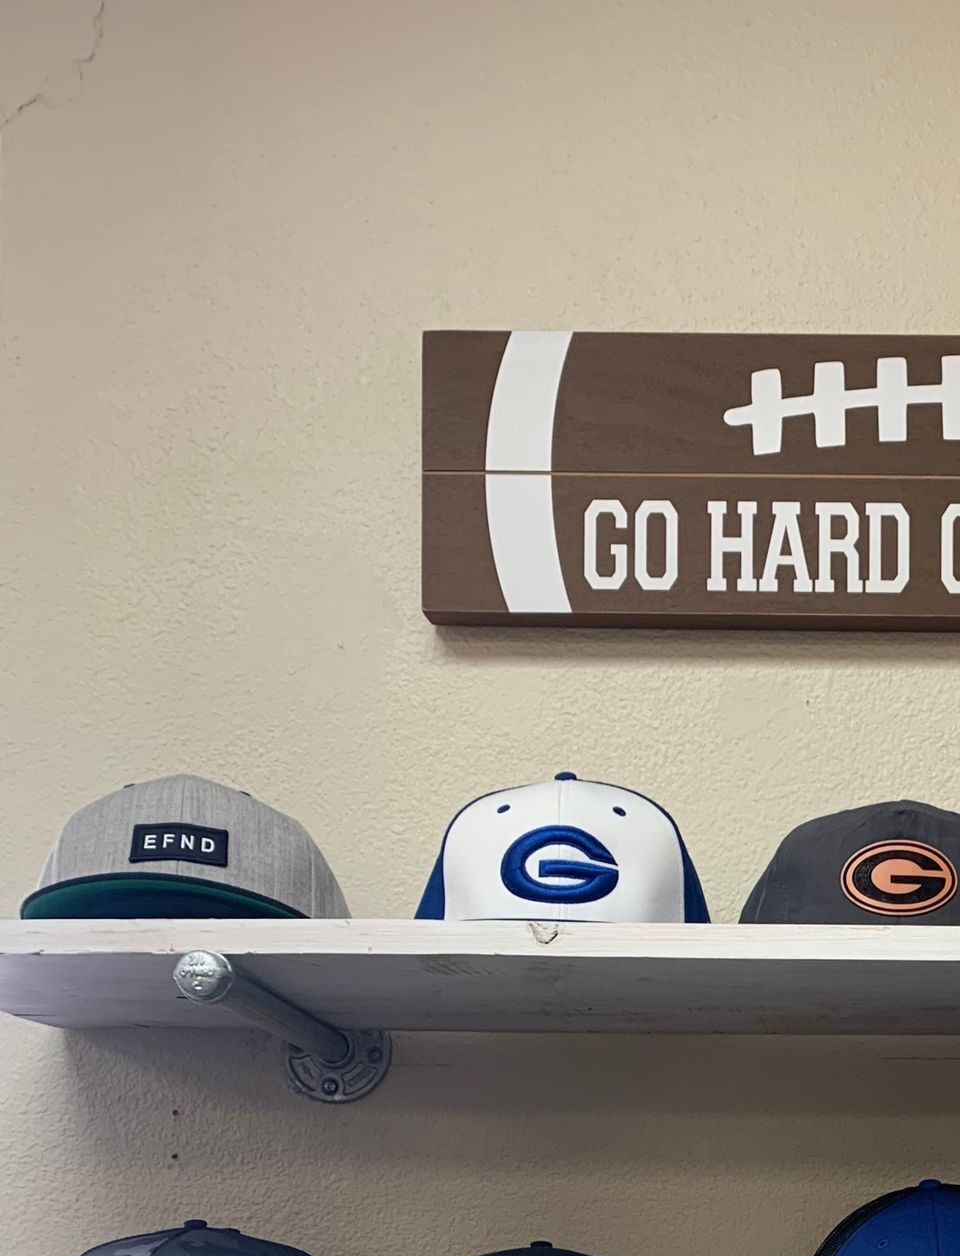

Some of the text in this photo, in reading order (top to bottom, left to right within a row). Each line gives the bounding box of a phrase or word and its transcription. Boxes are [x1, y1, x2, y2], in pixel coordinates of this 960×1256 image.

[584, 499, 678, 590] GO
[706, 501, 910, 593] HARD
[143, 833, 215, 853] EFND
[501, 825, 620, 904] G
[852, 850, 946, 904] G
